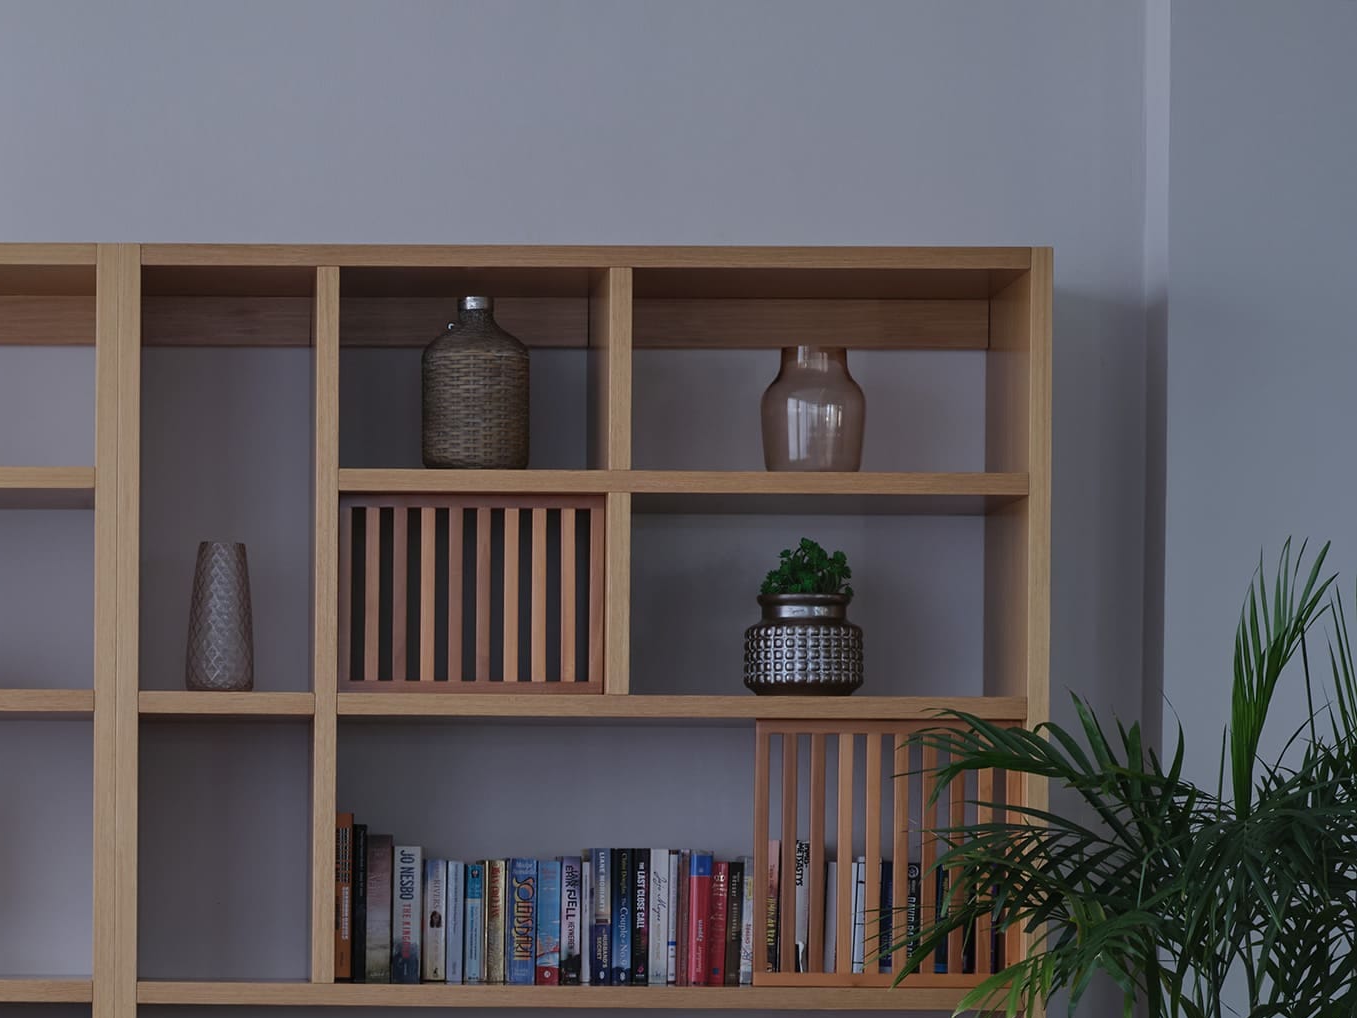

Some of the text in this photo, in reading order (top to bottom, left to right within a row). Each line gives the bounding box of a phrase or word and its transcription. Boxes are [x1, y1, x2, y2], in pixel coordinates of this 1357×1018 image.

[400, 850, 415, 864] JO
[636, 871, 645, 888] LAST
[565, 889, 577, 920] FJELL
[636, 889, 645, 911] CLOSE
[402, 904, 411, 918] THE
[618, 907, 628, 938] Couple
[636, 912, 645, 929] CALL
